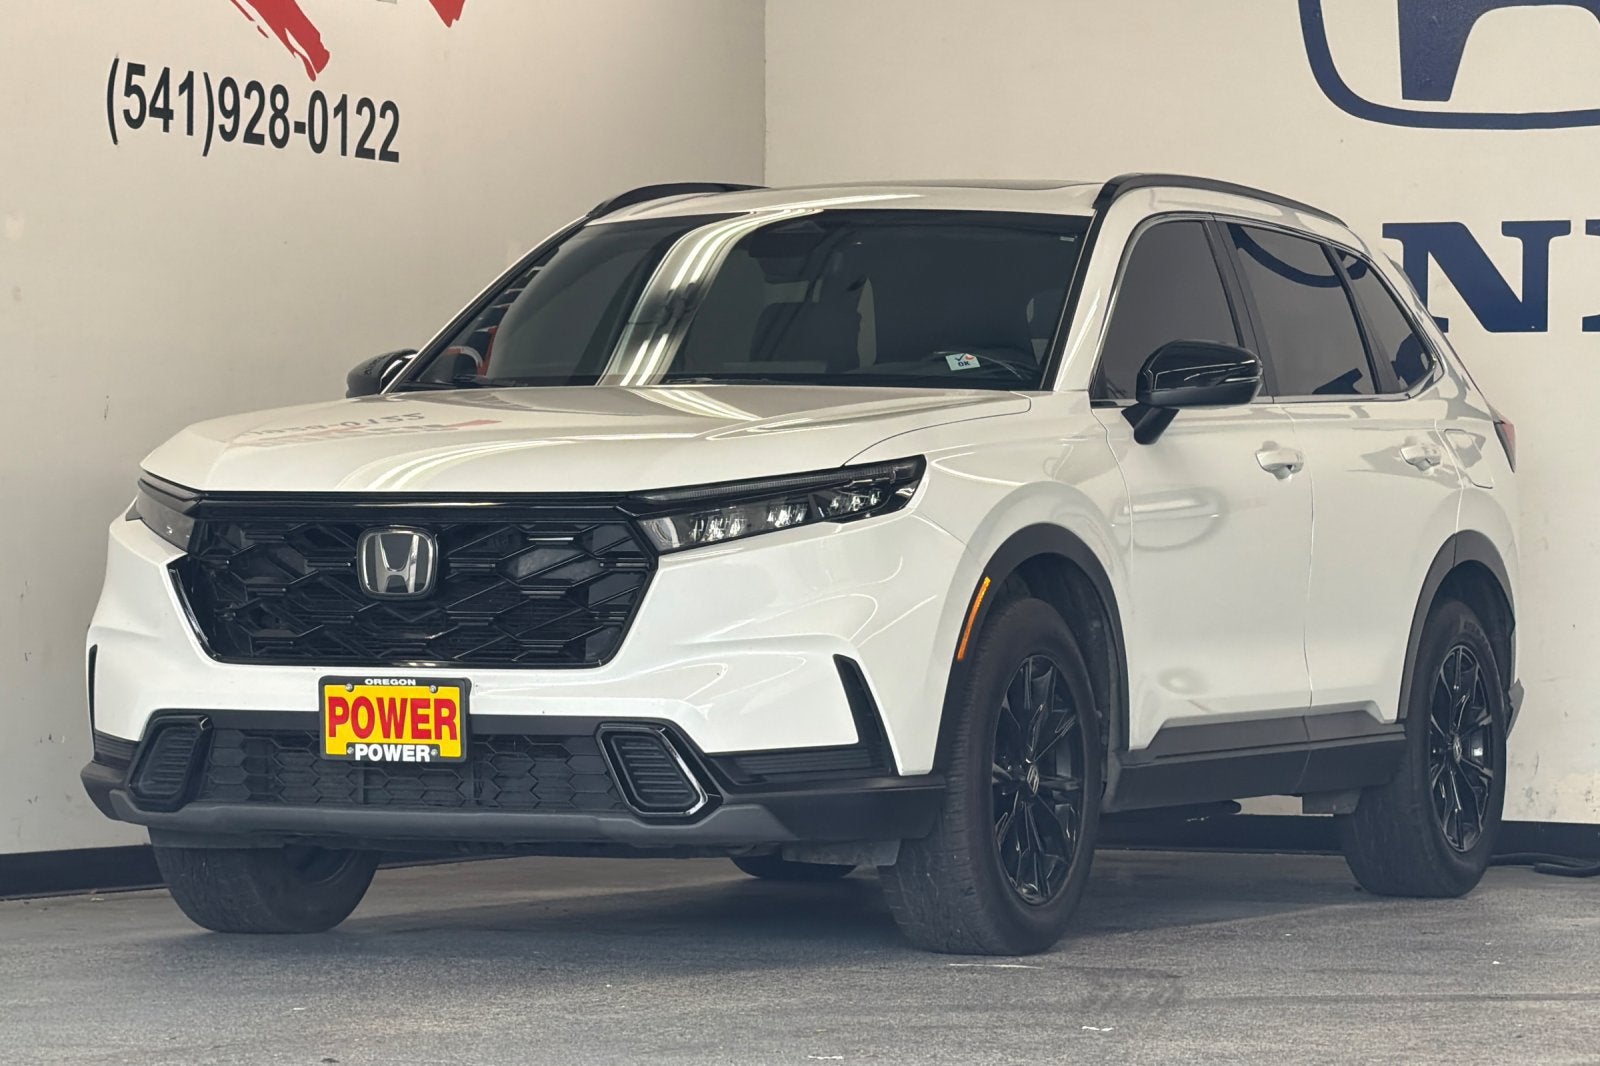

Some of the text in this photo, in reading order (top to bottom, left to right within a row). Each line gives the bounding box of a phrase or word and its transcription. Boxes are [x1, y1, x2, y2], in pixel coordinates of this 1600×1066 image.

[106, 56, 400, 163] (541)928-0122
[364, 678, 416, 686] OREGON
[327, 695, 458, 741] POWER
[354, 743, 431, 762] POWER
